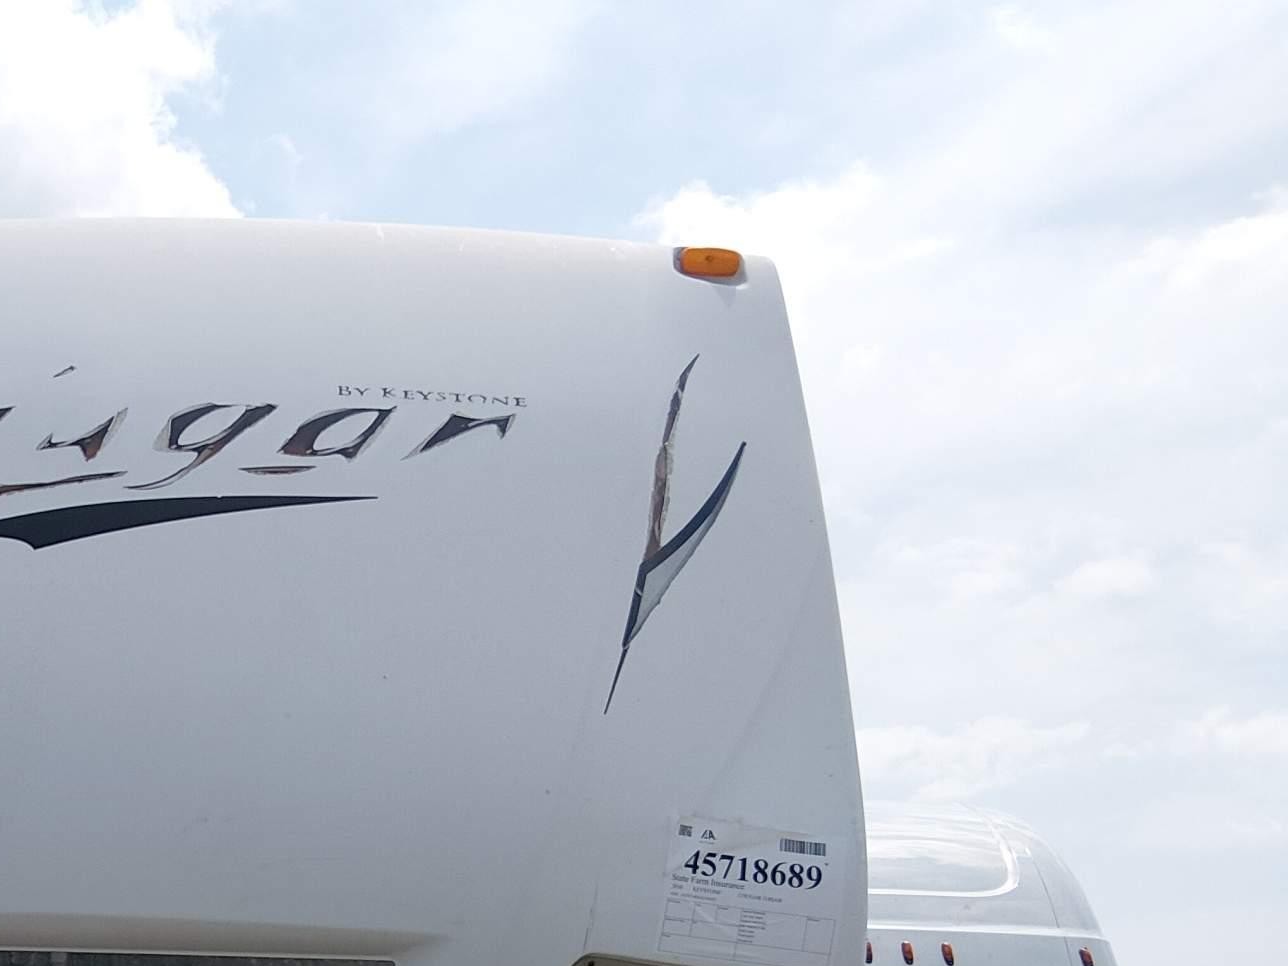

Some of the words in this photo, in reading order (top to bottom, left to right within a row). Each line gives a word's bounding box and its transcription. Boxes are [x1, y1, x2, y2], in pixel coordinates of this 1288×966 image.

[337, 385, 369, 397] BY
[380, 387, 528, 408] KEYSTONE
[683, 849, 823, 890] 45718689
[691, 876, 710, 886] Farm
[710, 879, 745, 890] Insurance
